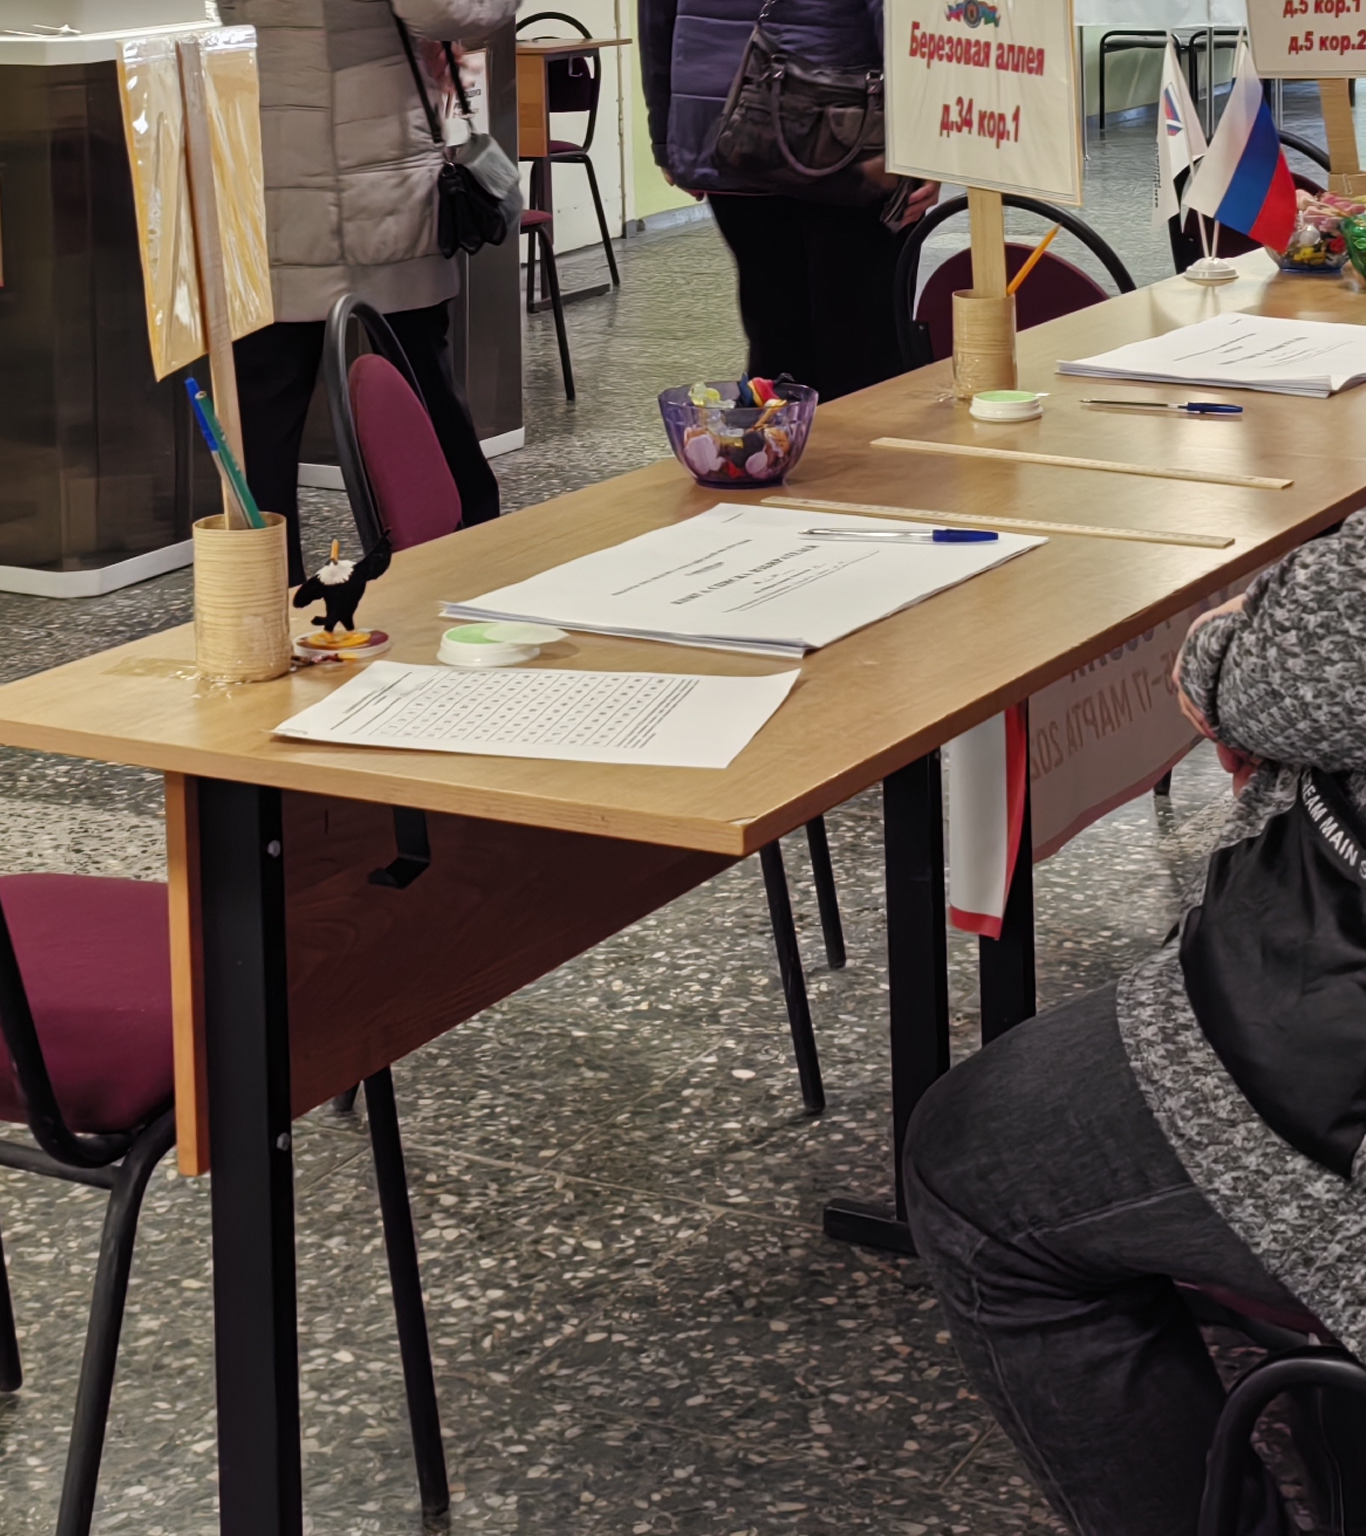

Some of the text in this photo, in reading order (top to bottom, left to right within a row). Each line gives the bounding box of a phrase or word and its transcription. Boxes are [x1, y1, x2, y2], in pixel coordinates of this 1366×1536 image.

[908, 20, 1046, 76] Березовая аллея
[1287, 30, 1315, 55] д.5
[939, 95, 1021, 149] д.34 кор.1
[1319, 816, 1359, 866] MAIN
